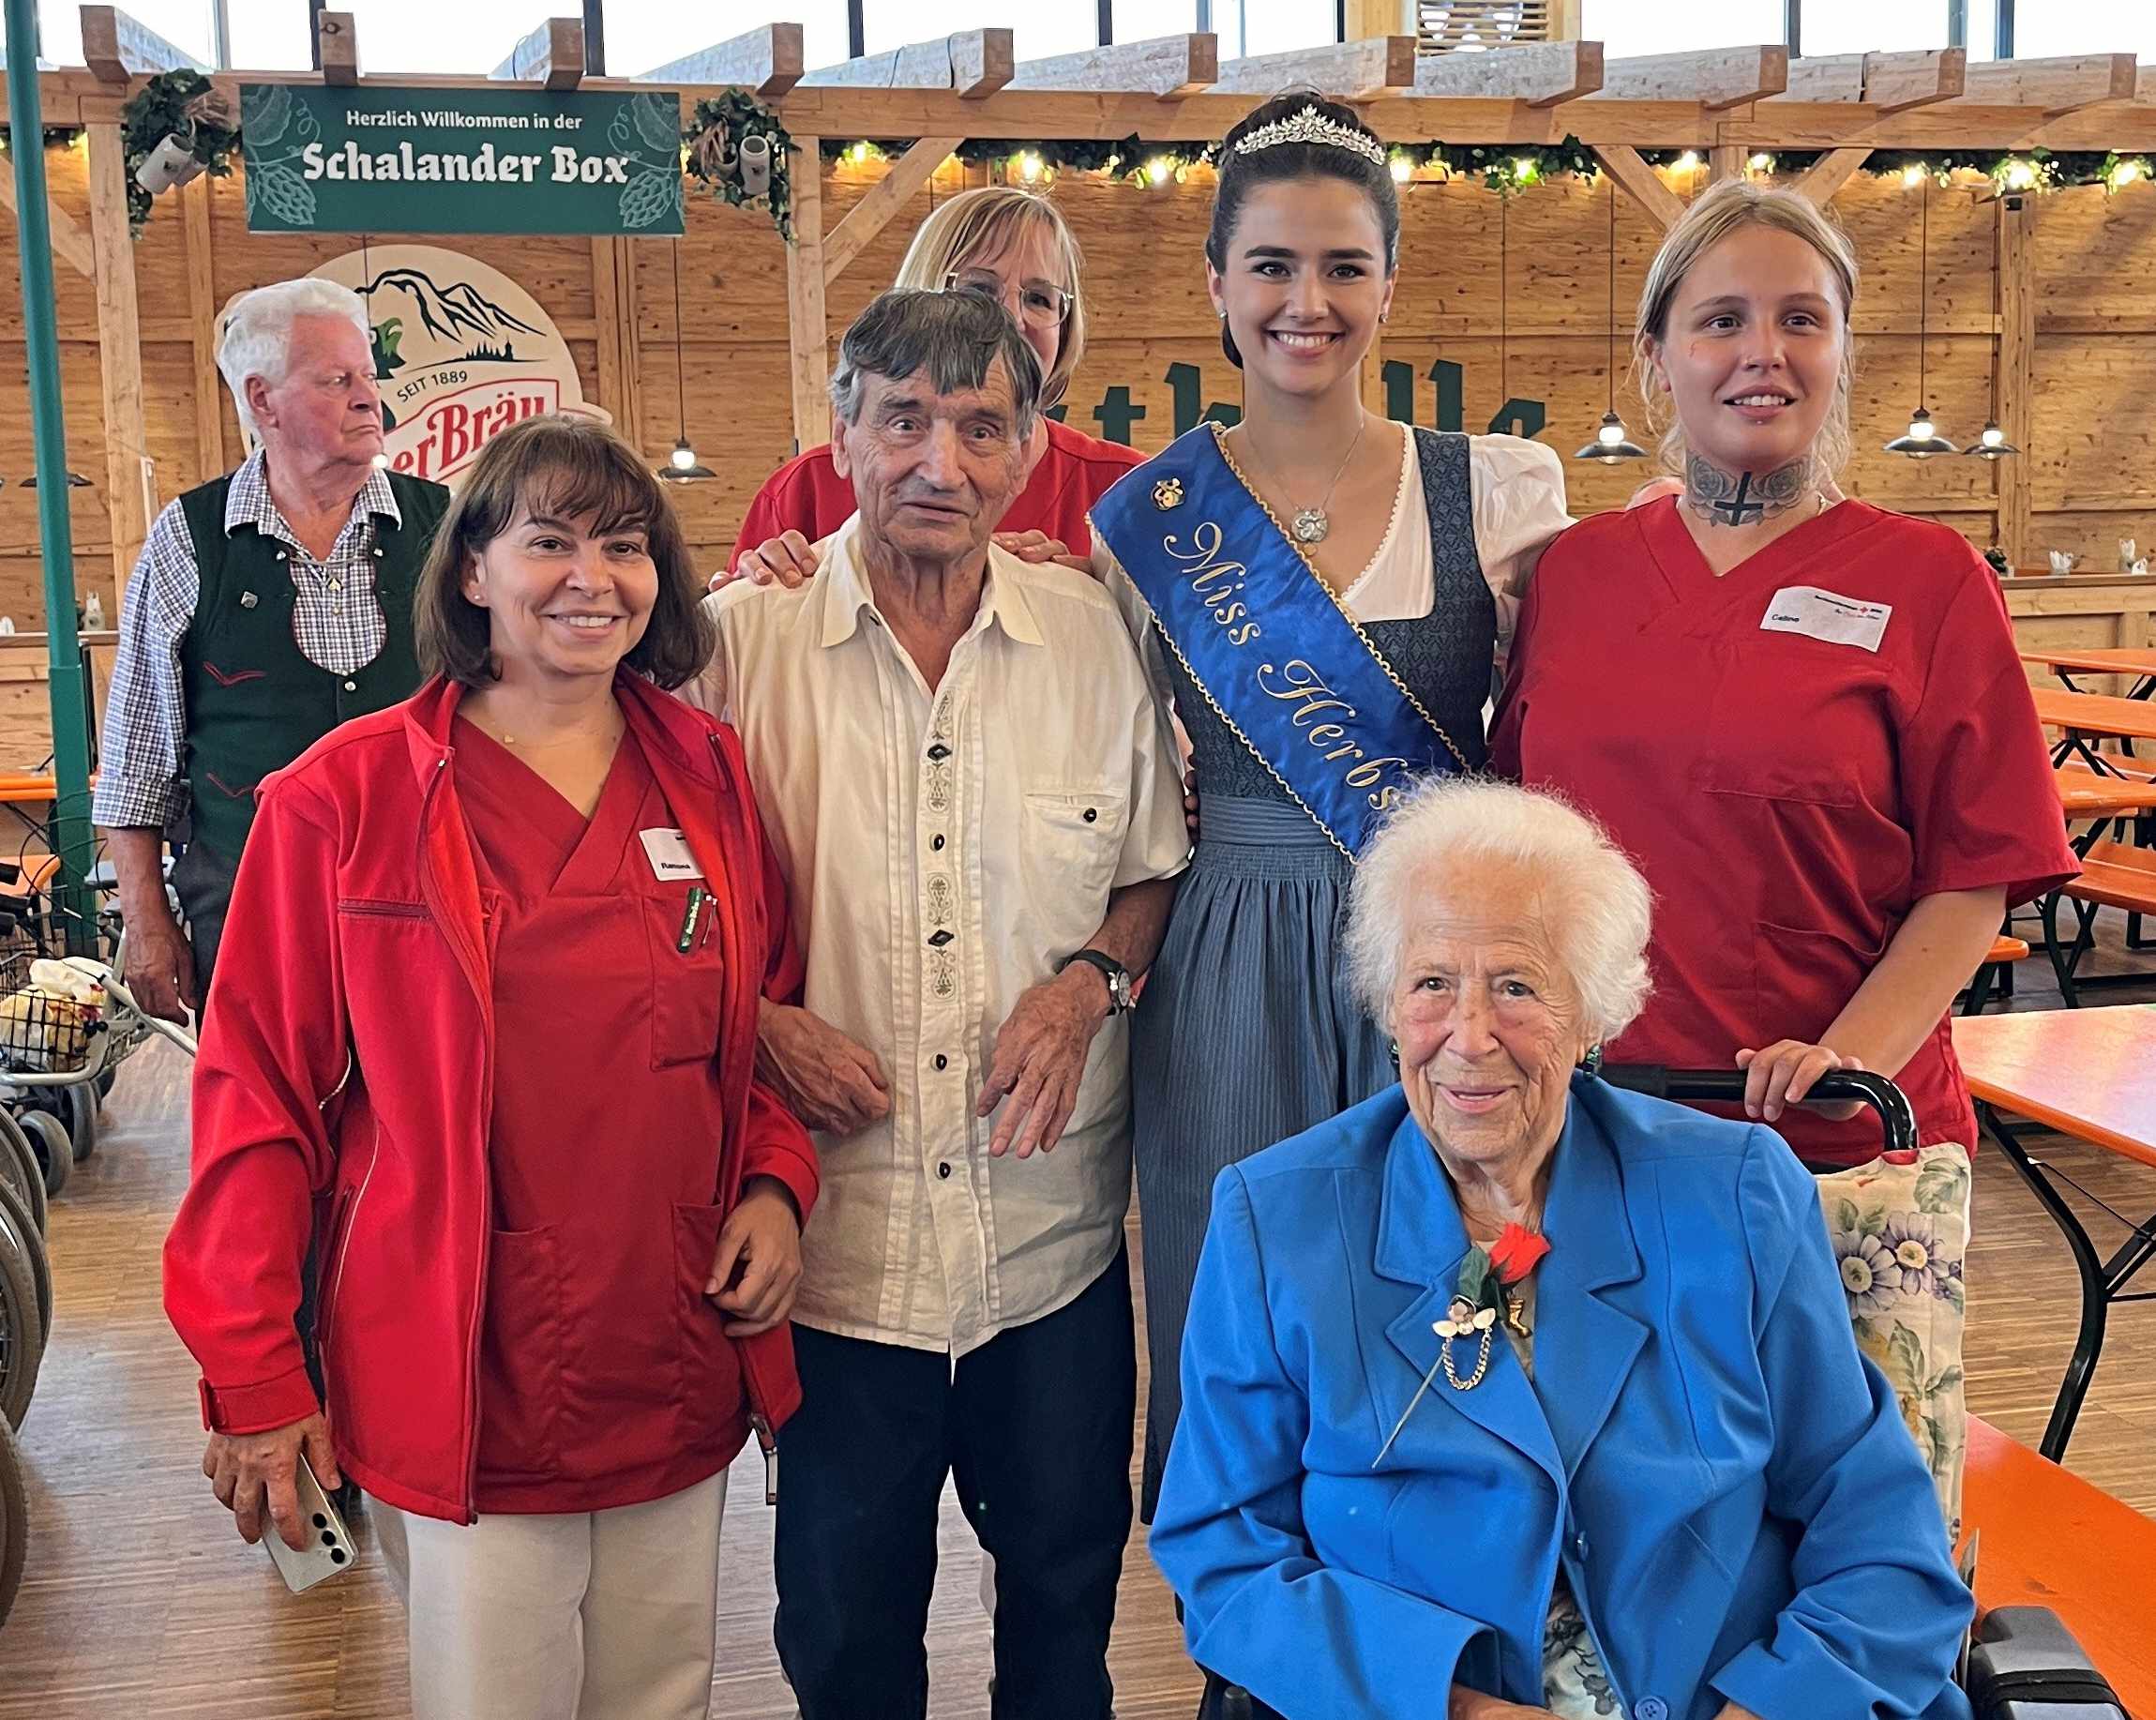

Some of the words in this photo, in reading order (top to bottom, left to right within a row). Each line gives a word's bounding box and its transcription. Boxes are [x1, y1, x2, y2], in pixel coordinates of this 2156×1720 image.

[346, 110, 417, 127] Herzlich
[420, 111, 529, 128] Willkommen
[534, 113, 550, 128] in
[553, 113, 582, 129] der
[302, 141, 542, 182] Schalander
[550, 145, 631, 184] Box
[397, 380, 428, 402] SEIT
[431, 370, 468, 386] 1889
[1163, 521, 1260, 646] Miss
